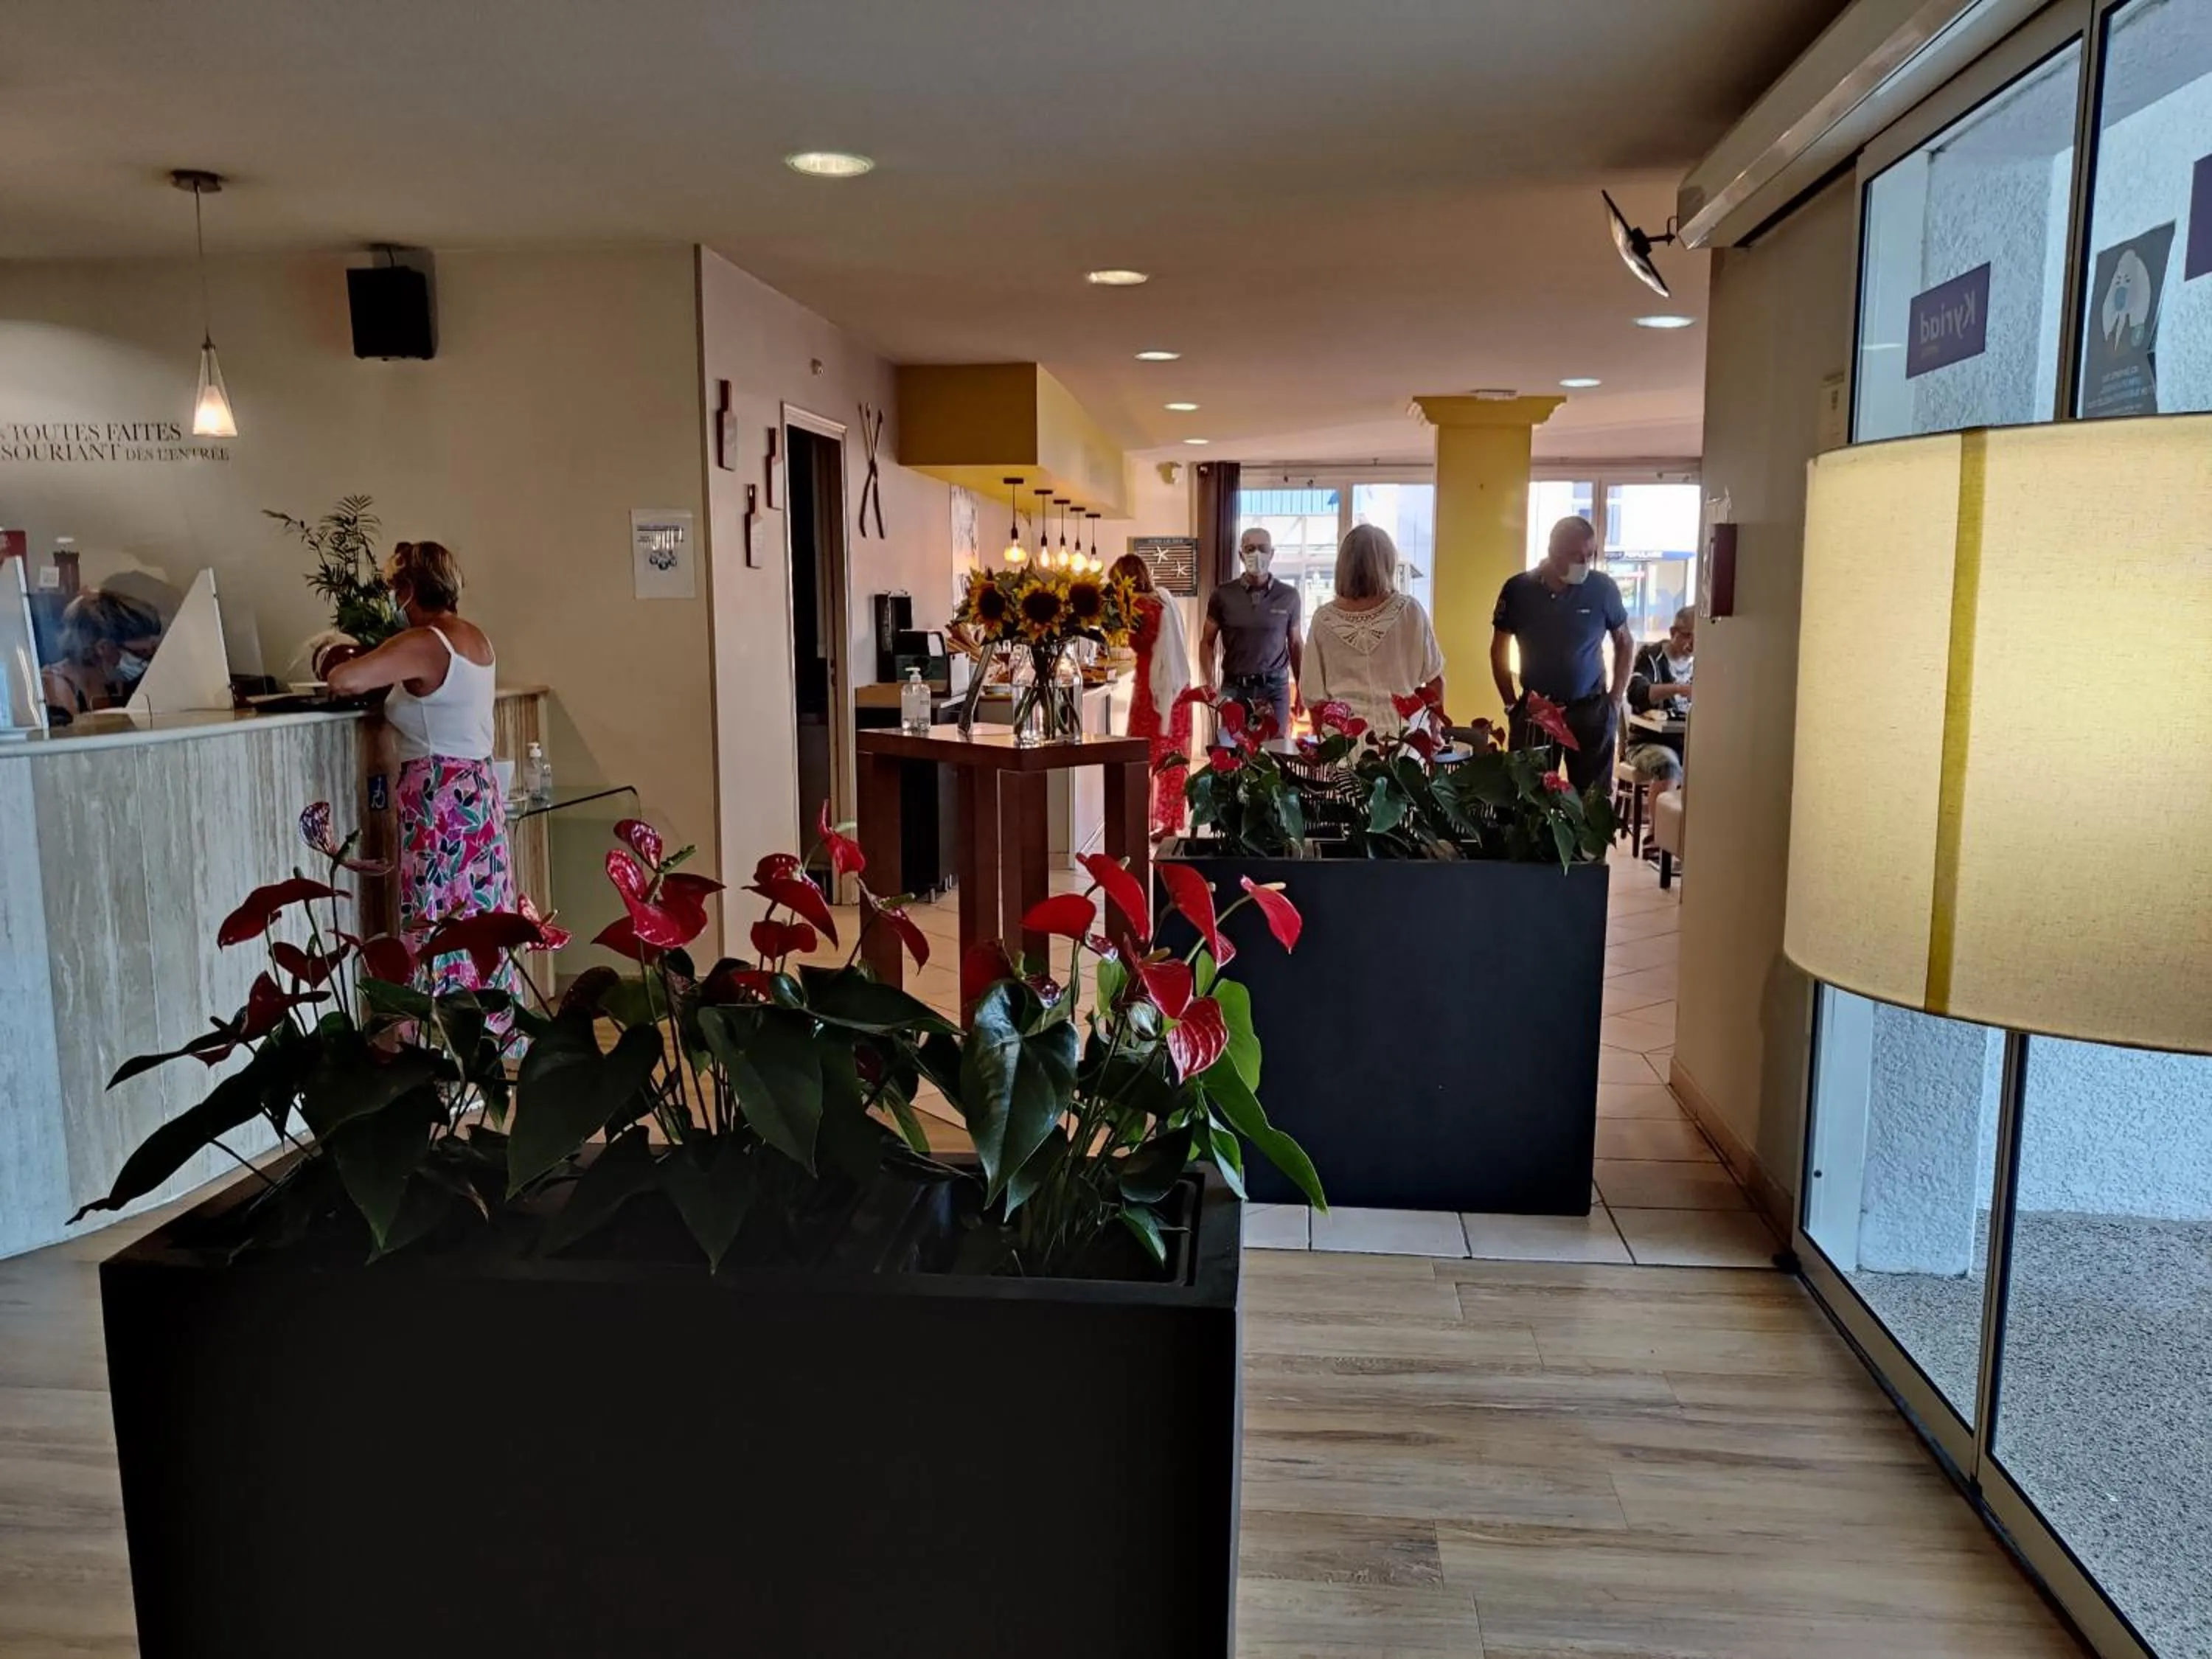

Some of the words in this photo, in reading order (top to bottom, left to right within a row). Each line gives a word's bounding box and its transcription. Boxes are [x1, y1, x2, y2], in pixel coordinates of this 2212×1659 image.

[13, 422, 101, 442] TOUTES
[106, 422, 181, 441] FAITES
[1, 442, 122, 461] SOURIANT
